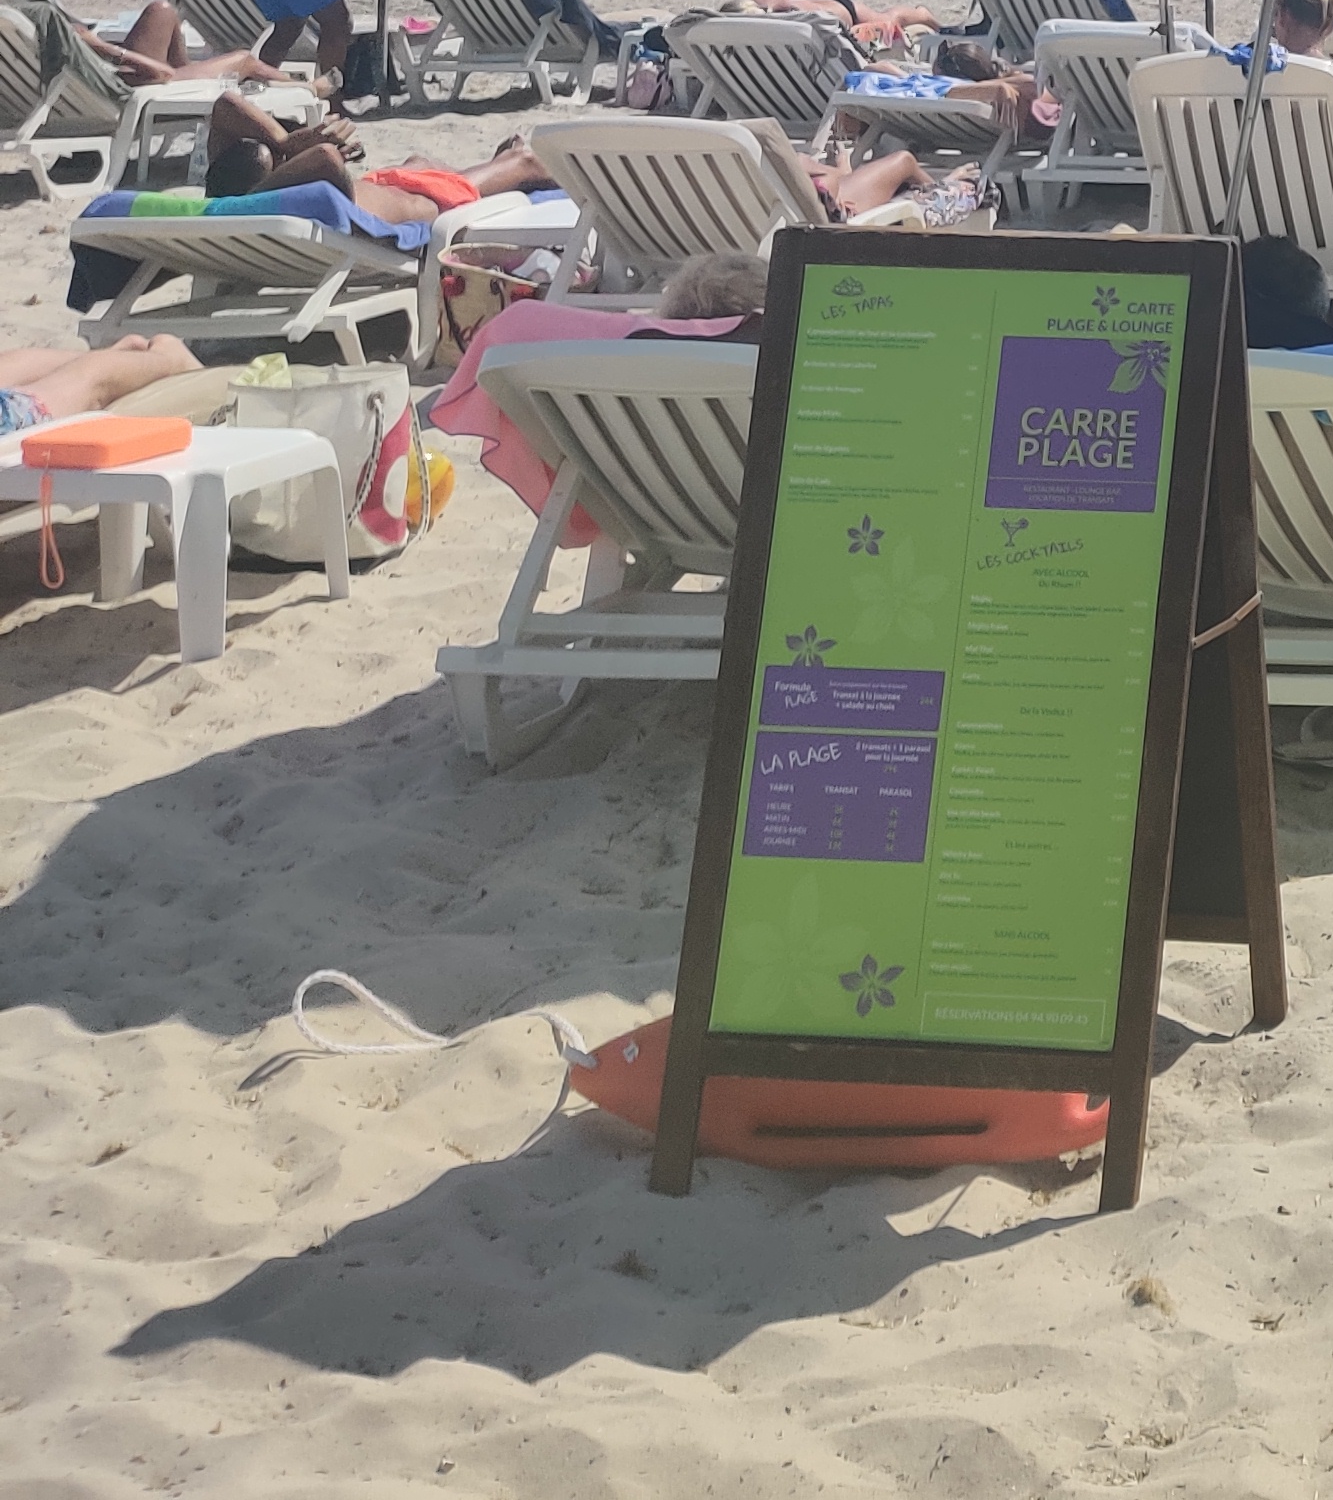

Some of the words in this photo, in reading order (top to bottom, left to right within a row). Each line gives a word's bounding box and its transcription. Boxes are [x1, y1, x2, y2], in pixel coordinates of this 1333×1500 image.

[820, 304, 847, 321] LES
[853, 295, 894, 315] TAPAS
[1127, 302, 1176, 316] CARTE
[1047, 318, 1095, 332] PLAGE
[1097, 319, 1108, 332] &
[1112, 320, 1174, 334] LOUNGE
[1020, 406, 1140, 439] CARRE
[1017, 437, 1137, 469] PLAGE
[977, 554, 1002, 571] LES
[1006, 538, 1085, 565] COCKTAILS
[1032, 569, 1055, 578] AVEC
[1056, 569, 1089, 579] ALCOOL
[774, 681, 812, 693] Formule
[784, 690, 819, 710] PLAGE
[760, 754, 784, 775] LA
[788, 742, 842, 770] PLAGE
[824, 785, 859, 796] TRANSAT
[879, 787, 913, 798] PARASOL
[1017, 931, 1050, 940] ALCOOL
